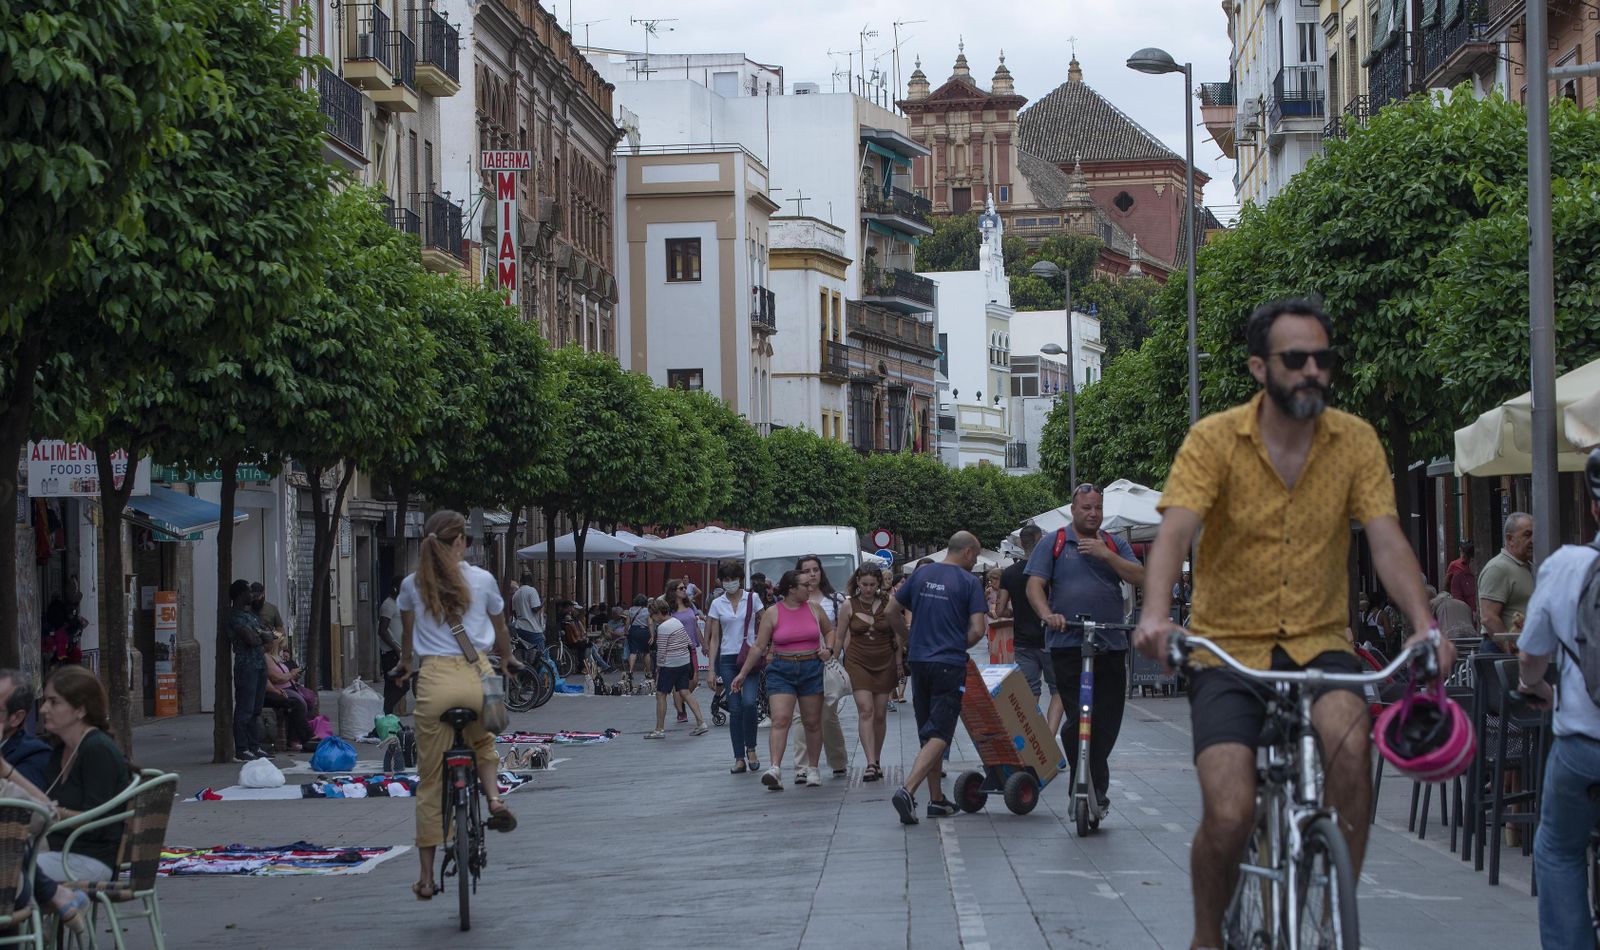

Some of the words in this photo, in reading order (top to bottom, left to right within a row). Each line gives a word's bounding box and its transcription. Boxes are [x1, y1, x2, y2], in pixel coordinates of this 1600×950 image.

[483, 152, 530, 168] TABERNA
[51, 464, 81, 475] FOOD
[84, 464, 128, 475] STES
[925, 581, 945, 591] TIPSA
[1008, 693, 1027, 723] SPAIN
[1023, 722, 1033, 735] IN
[1029, 735, 1047, 764] MADE
